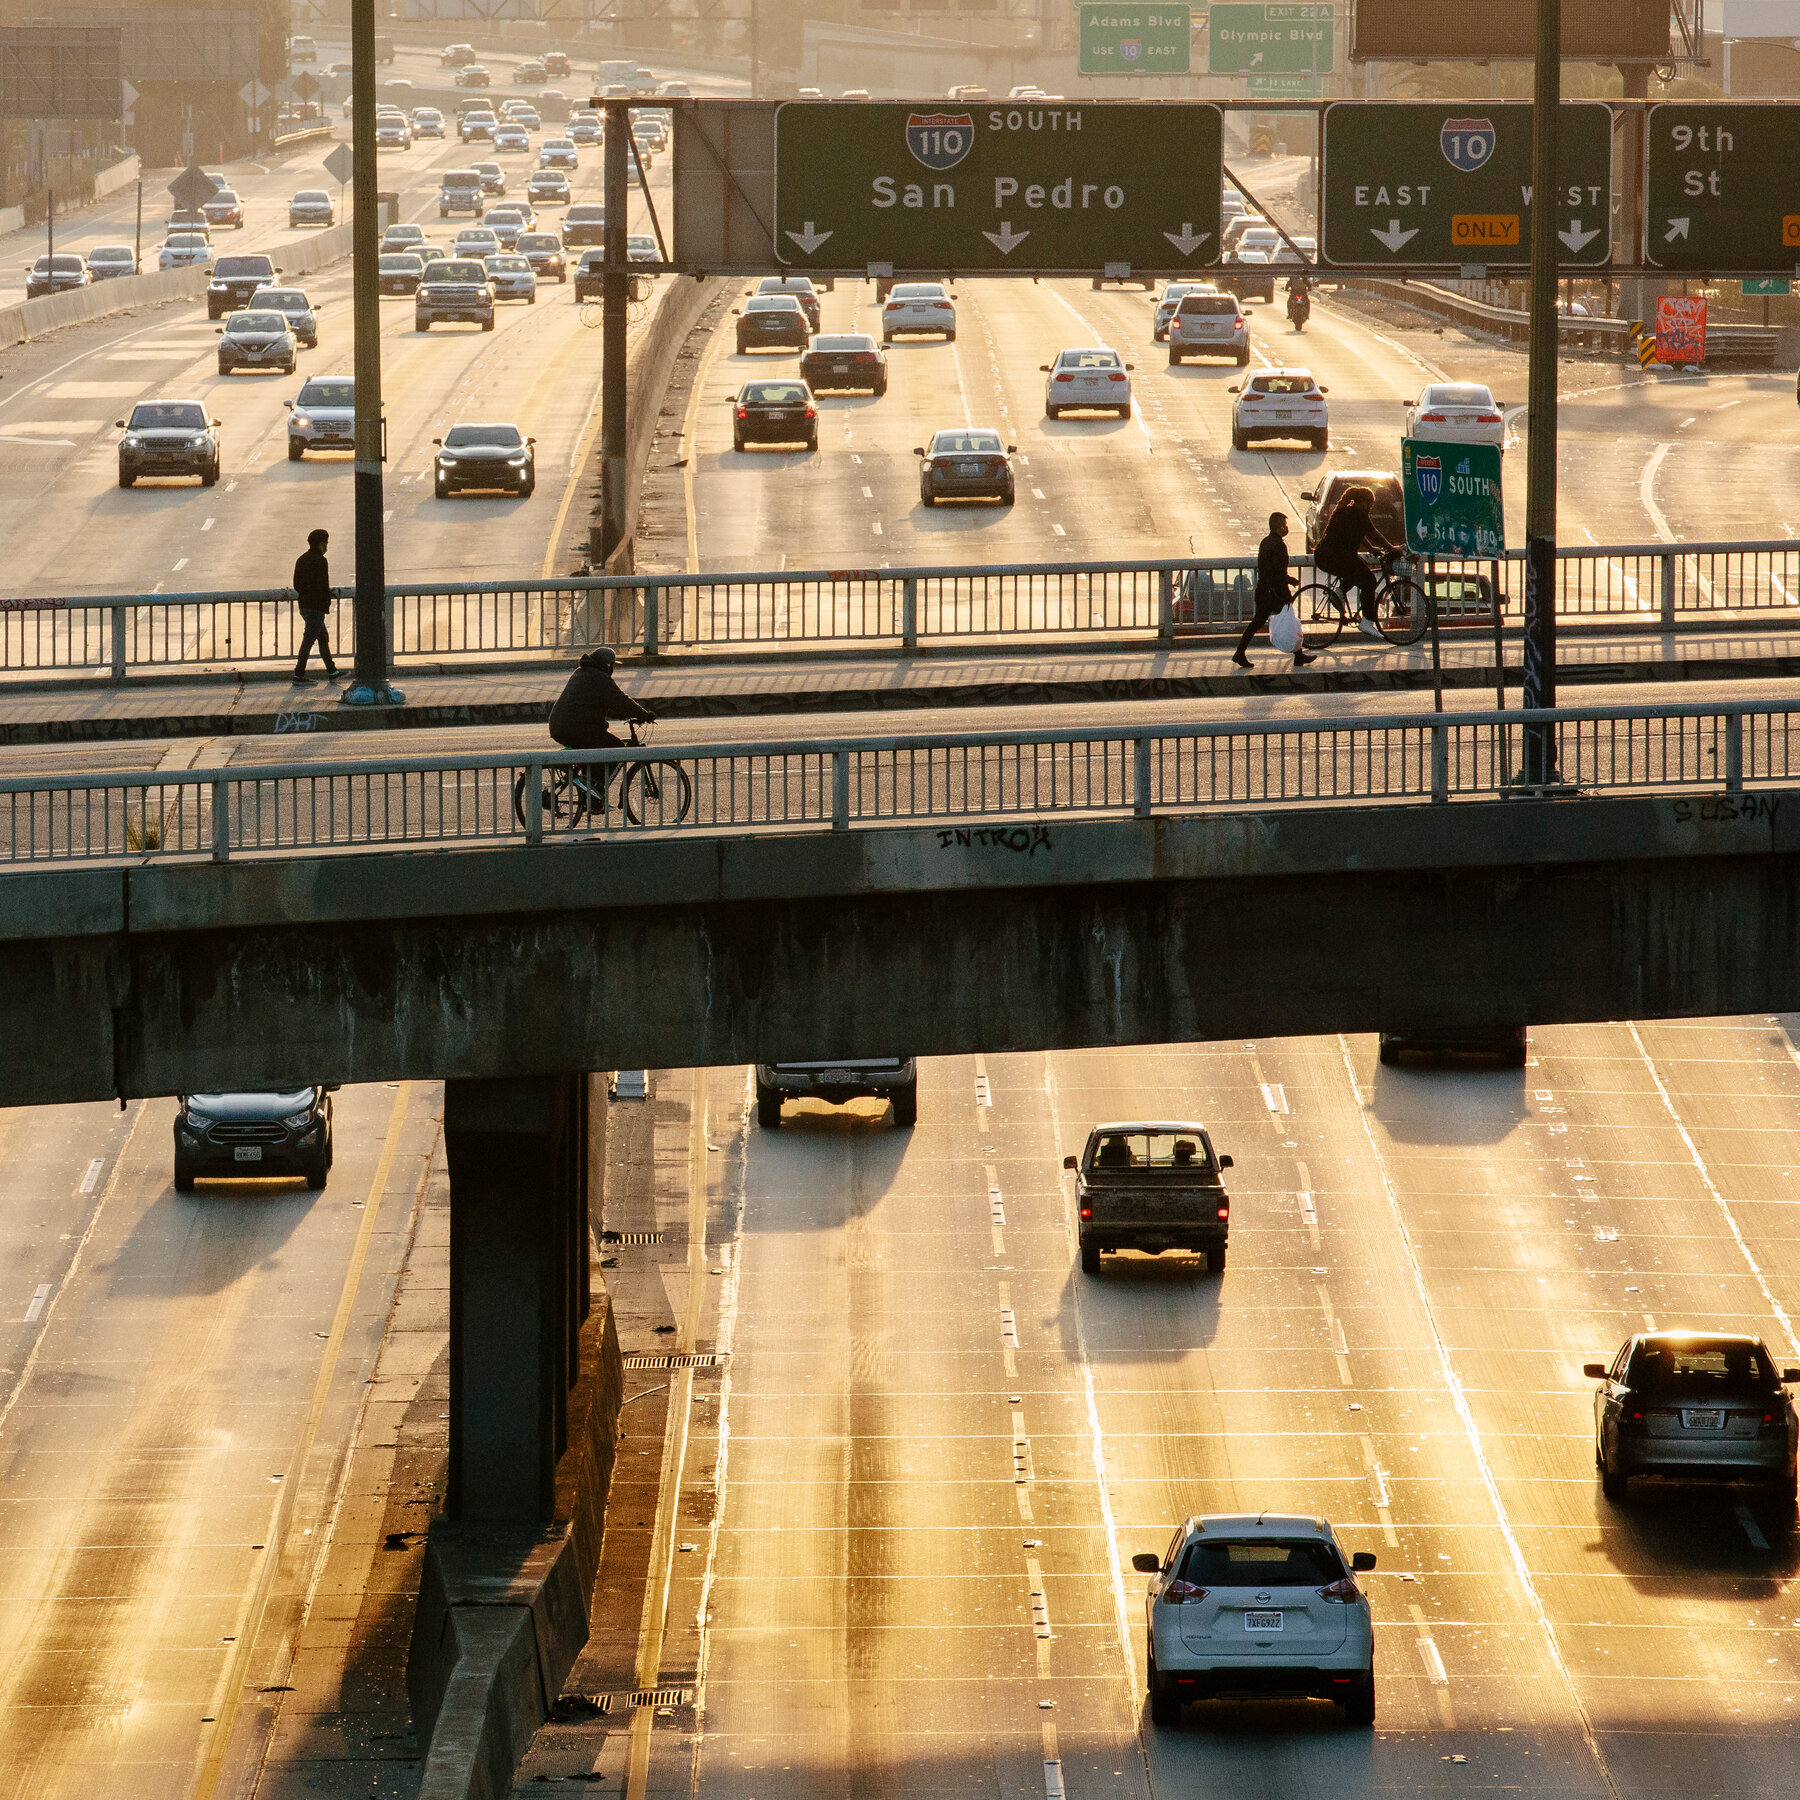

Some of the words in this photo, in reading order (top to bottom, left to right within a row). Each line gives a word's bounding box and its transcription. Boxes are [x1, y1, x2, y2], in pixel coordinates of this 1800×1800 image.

[1089, 16, 1140, 27] Adams
[1148, 16, 1181, 27] Blvd
[1269, 7, 1295, 16] EXIT
[1220, 29, 1281, 42] Olympic
[1290, 30, 1323, 41] Blvd
[1093, 47, 1114, 55] USE
[1124, 46, 1137, 56] 10
[1148, 47, 1176, 55] EAST
[920, 130, 963, 155] 110
[988, 110, 1082, 131] SOUTH
[1671, 125, 1734, 152] 9th
[1451, 135, 1487, 160] 10
[871, 176, 955, 208] San
[995, 177, 1125, 209] Pedro
[1683, 170, 1720, 196] St
[1355, 186, 1431, 206] EAST
[1521, 186, 1601, 206] WST
[1456, 221, 1514, 239] ONLY
[1422, 474, 1438, 492] 110
[1449, 475, 1490, 496] SOUTH
[1247, 1618, 1280, 1628] 7XFG922
